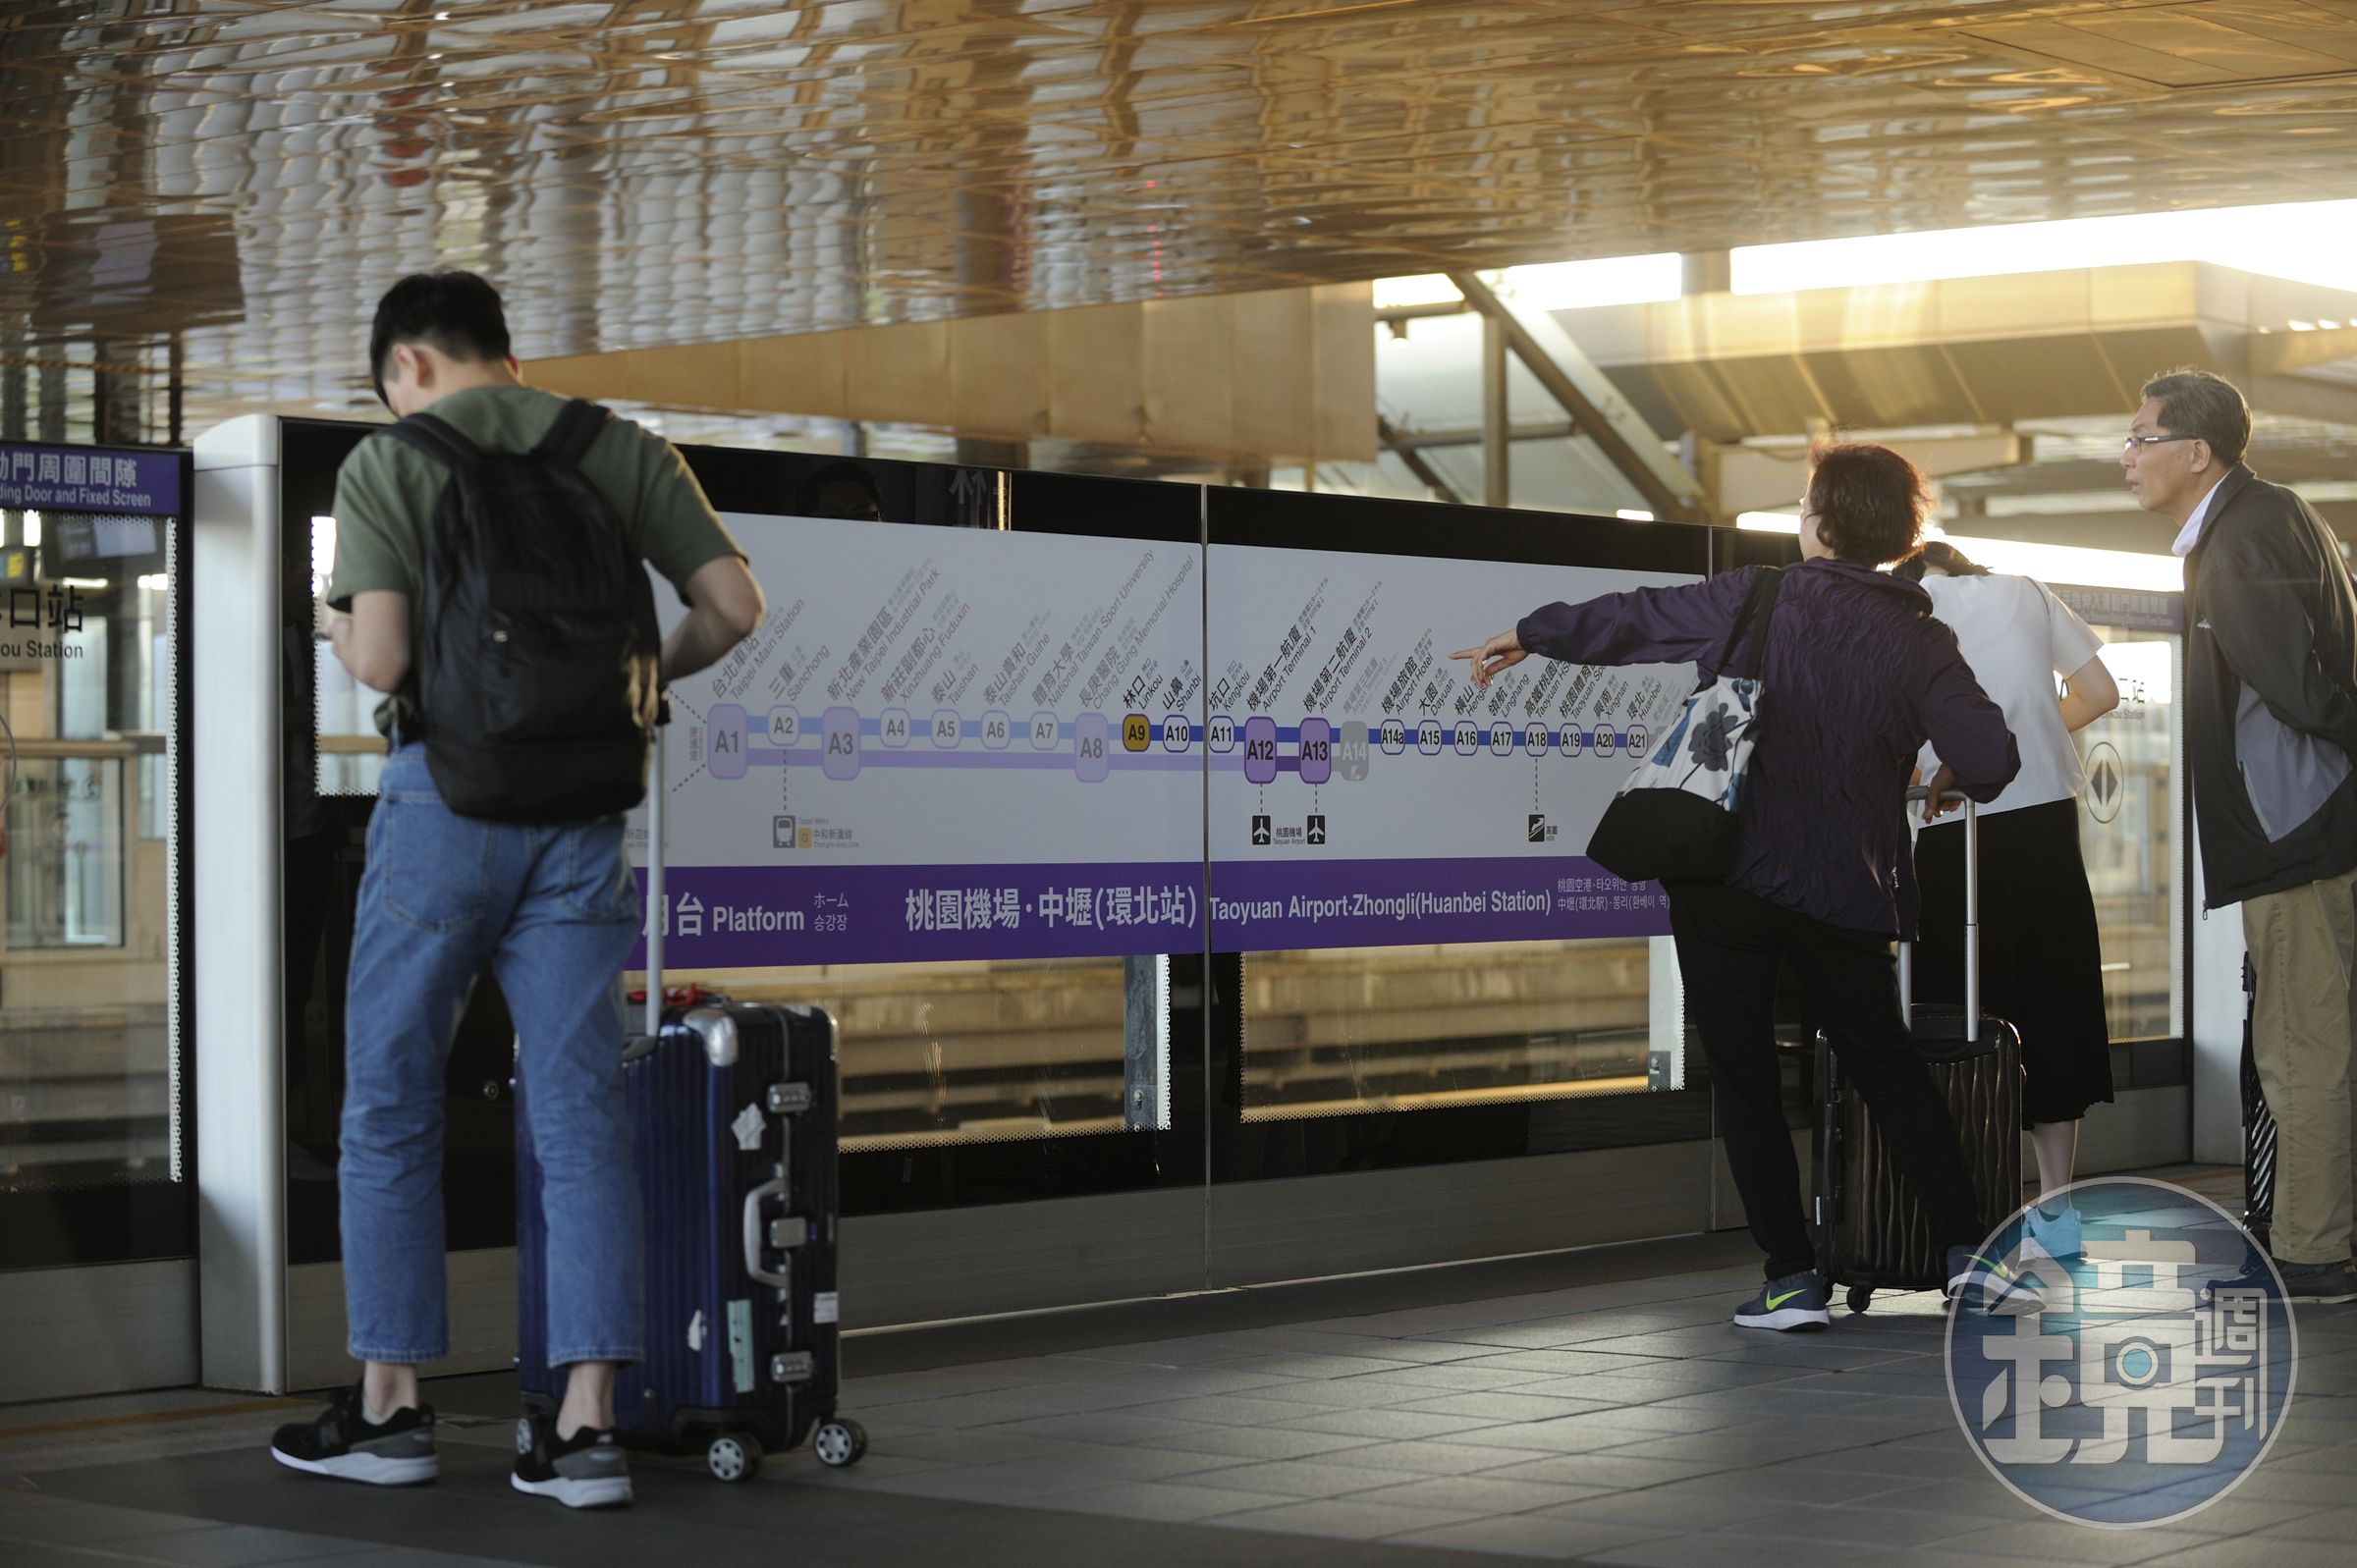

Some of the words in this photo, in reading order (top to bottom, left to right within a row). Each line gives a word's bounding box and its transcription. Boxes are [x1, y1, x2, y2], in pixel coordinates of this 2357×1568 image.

[25, 484, 52, 503] Door
[55, 489, 77, 504] and
[80, 488, 110, 506] Fixed
[113, 489, 151, 508] Screen
[0, 584, 83, 633] 口站
[846, 676, 865, 703] New
[863, 643, 889, 676] Taipei
[885, 592, 921, 645] Industrial
[919, 568, 940, 597] Park
[1048, 662, 1081, 707] National
[1075, 627, 1104, 665] Taiwan
[1100, 597, 1123, 629] Sport
[1119, 549, 1154, 600] University
[1093, 674, 1120, 709] Chang
[1116, 643, 1140, 676] Gung
[1134, 597, 1170, 646] Memorial
[1165, 554, 1194, 601] Hospital
[27, 639, 83, 659] Station
[730, 664, 757, 699] Taipei
[753, 638, 777, 669] Main
[774, 598, 805, 639] Station
[900, 646, 943, 704] Xinzhuang
[937, 602, 970, 647] Fuduxin
[712, 637, 760, 698] 台北車站
[768, 661, 795, 700] 三重
[787, 644, 831, 702] Sanchong
[999, 666, 1029, 706] Taishan
[1026, 633, 1051, 667] Guihe
[1262, 676, 1287, 713] Airport
[1283, 633, 1312, 676] Terminal
[1318, 676, 1343, 715] Airport
[1338, 633, 1367, 678] Terminal
[1395, 678, 1417, 716] Airport
[1413, 651, 1434, 682] Hotel
[931, 669, 958, 705] 泰山
[948, 664, 980, 705] Taishan
[1123, 675, 1146, 709] 林口
[1138, 674, 1164, 710] Linkou
[1162, 676, 1183, 711] 山鼻
[1176, 672, 1202, 712] Shanbi
[1208, 677, 1231, 711] 坑口
[1223, 671, 1251, 712] Kengkou
[1381, 656, 1418, 715] 機場旅館
[1430, 678, 1455, 717] Dayuan
[1502, 674, 1530, 718] Linghang
[1536, 678, 1561, 719] Taoyuan
[1560, 665, 1594, 718] 桃園體育
[1571, 681, 1596, 720] Taoyuan
[1605, 681, 1630, 720] Xingnan
[1638, 680, 1663, 722] Huanbei
[1489, 686, 1508, 717] 領航
[1593, 687, 1612, 720] 興南
[1626, 690, 1646, 720] 環北
[714, 730, 740, 753] A1
[773, 717, 795, 735] A2
[885, 719, 905, 736] A4
[937, 721, 956, 737] A5
[986, 722, 1006, 738] A6
[1035, 723, 1054, 739] A7
[1127, 725, 1146, 741] A9
[1165, 726, 1188, 743] A10
[1211, 727, 1233, 743] A11
[1381, 730, 1404, 744] A14a
[1420, 730, 1441, 745] A15
[1455, 730, 1476, 746] A16
[1492, 731, 1512, 746] A17
[1527, 732, 1547, 747] A18
[1562, 732, 1581, 748] A19
[1595, 733, 1615, 748] A20
[1628, 733, 1646, 748] A21
[828, 731, 853, 755] A3
[1079, 737, 1103, 758] A8
[1246, 741, 1274, 761] A12
[1301, 741, 1328, 761] A13
[1342, 741, 1368, 762] A14
[813, 892, 850, 909] ホーム
[1210, 895, 1283, 926] Taoyuan
[1491, 889, 1552, 917] Station)
[713, 905, 805, 933] Platform
[813, 914, 849, 932] 승강장
